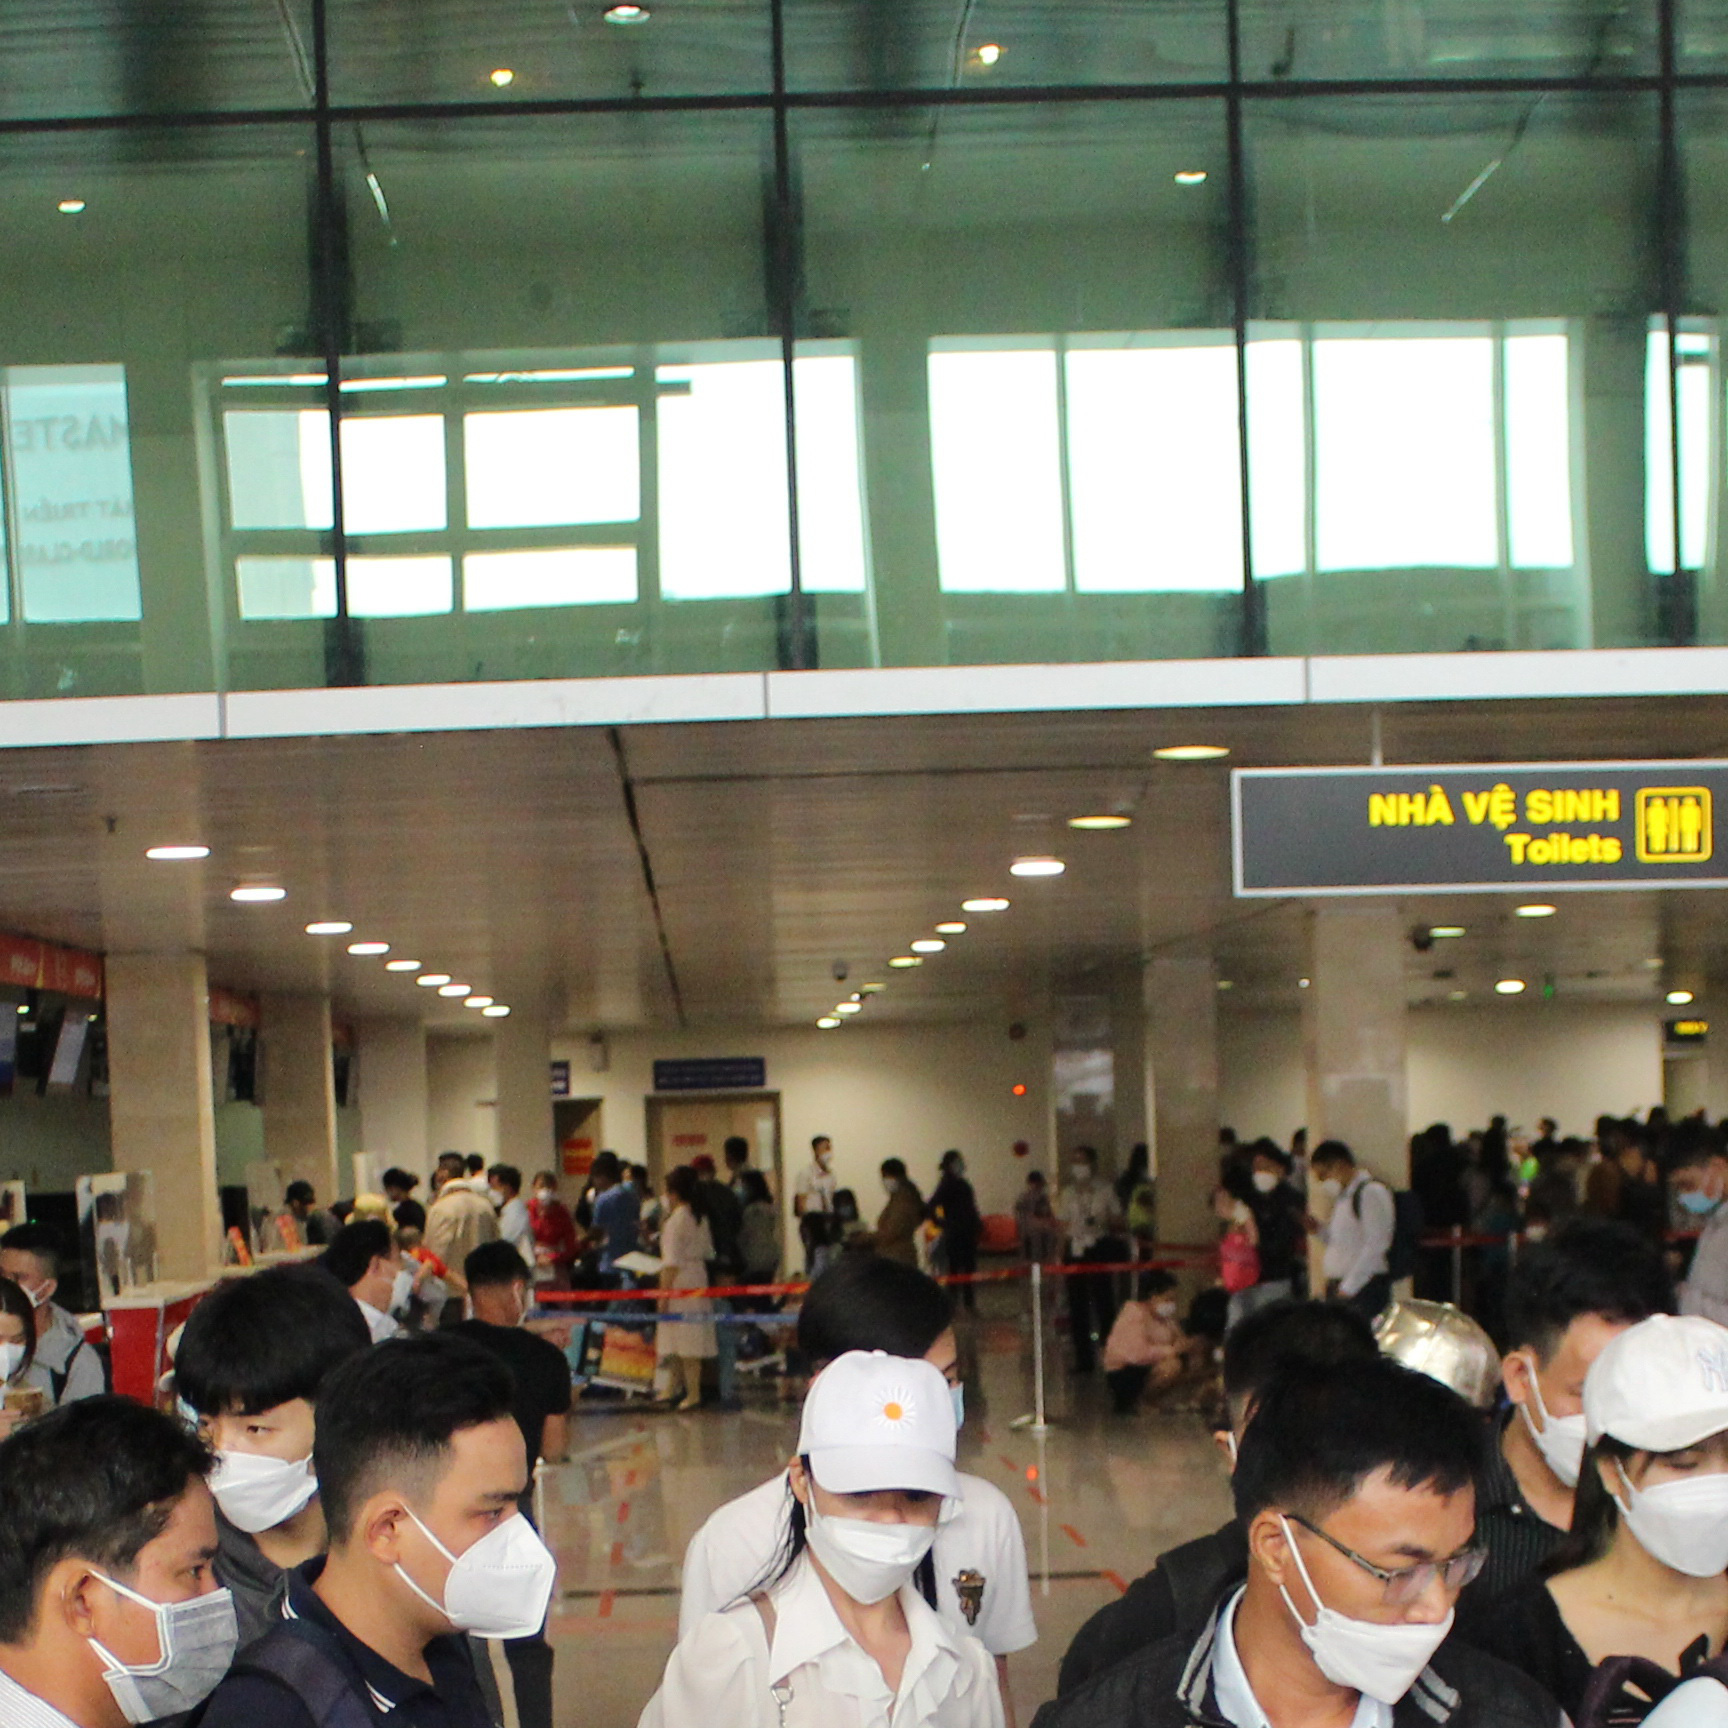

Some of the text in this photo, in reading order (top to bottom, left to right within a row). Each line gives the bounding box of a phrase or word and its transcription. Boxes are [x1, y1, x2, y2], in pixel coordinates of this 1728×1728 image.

[1368, 782, 1621, 831] NHÀ VỆ SINH
[1503, 832, 1622, 865] Toilets
